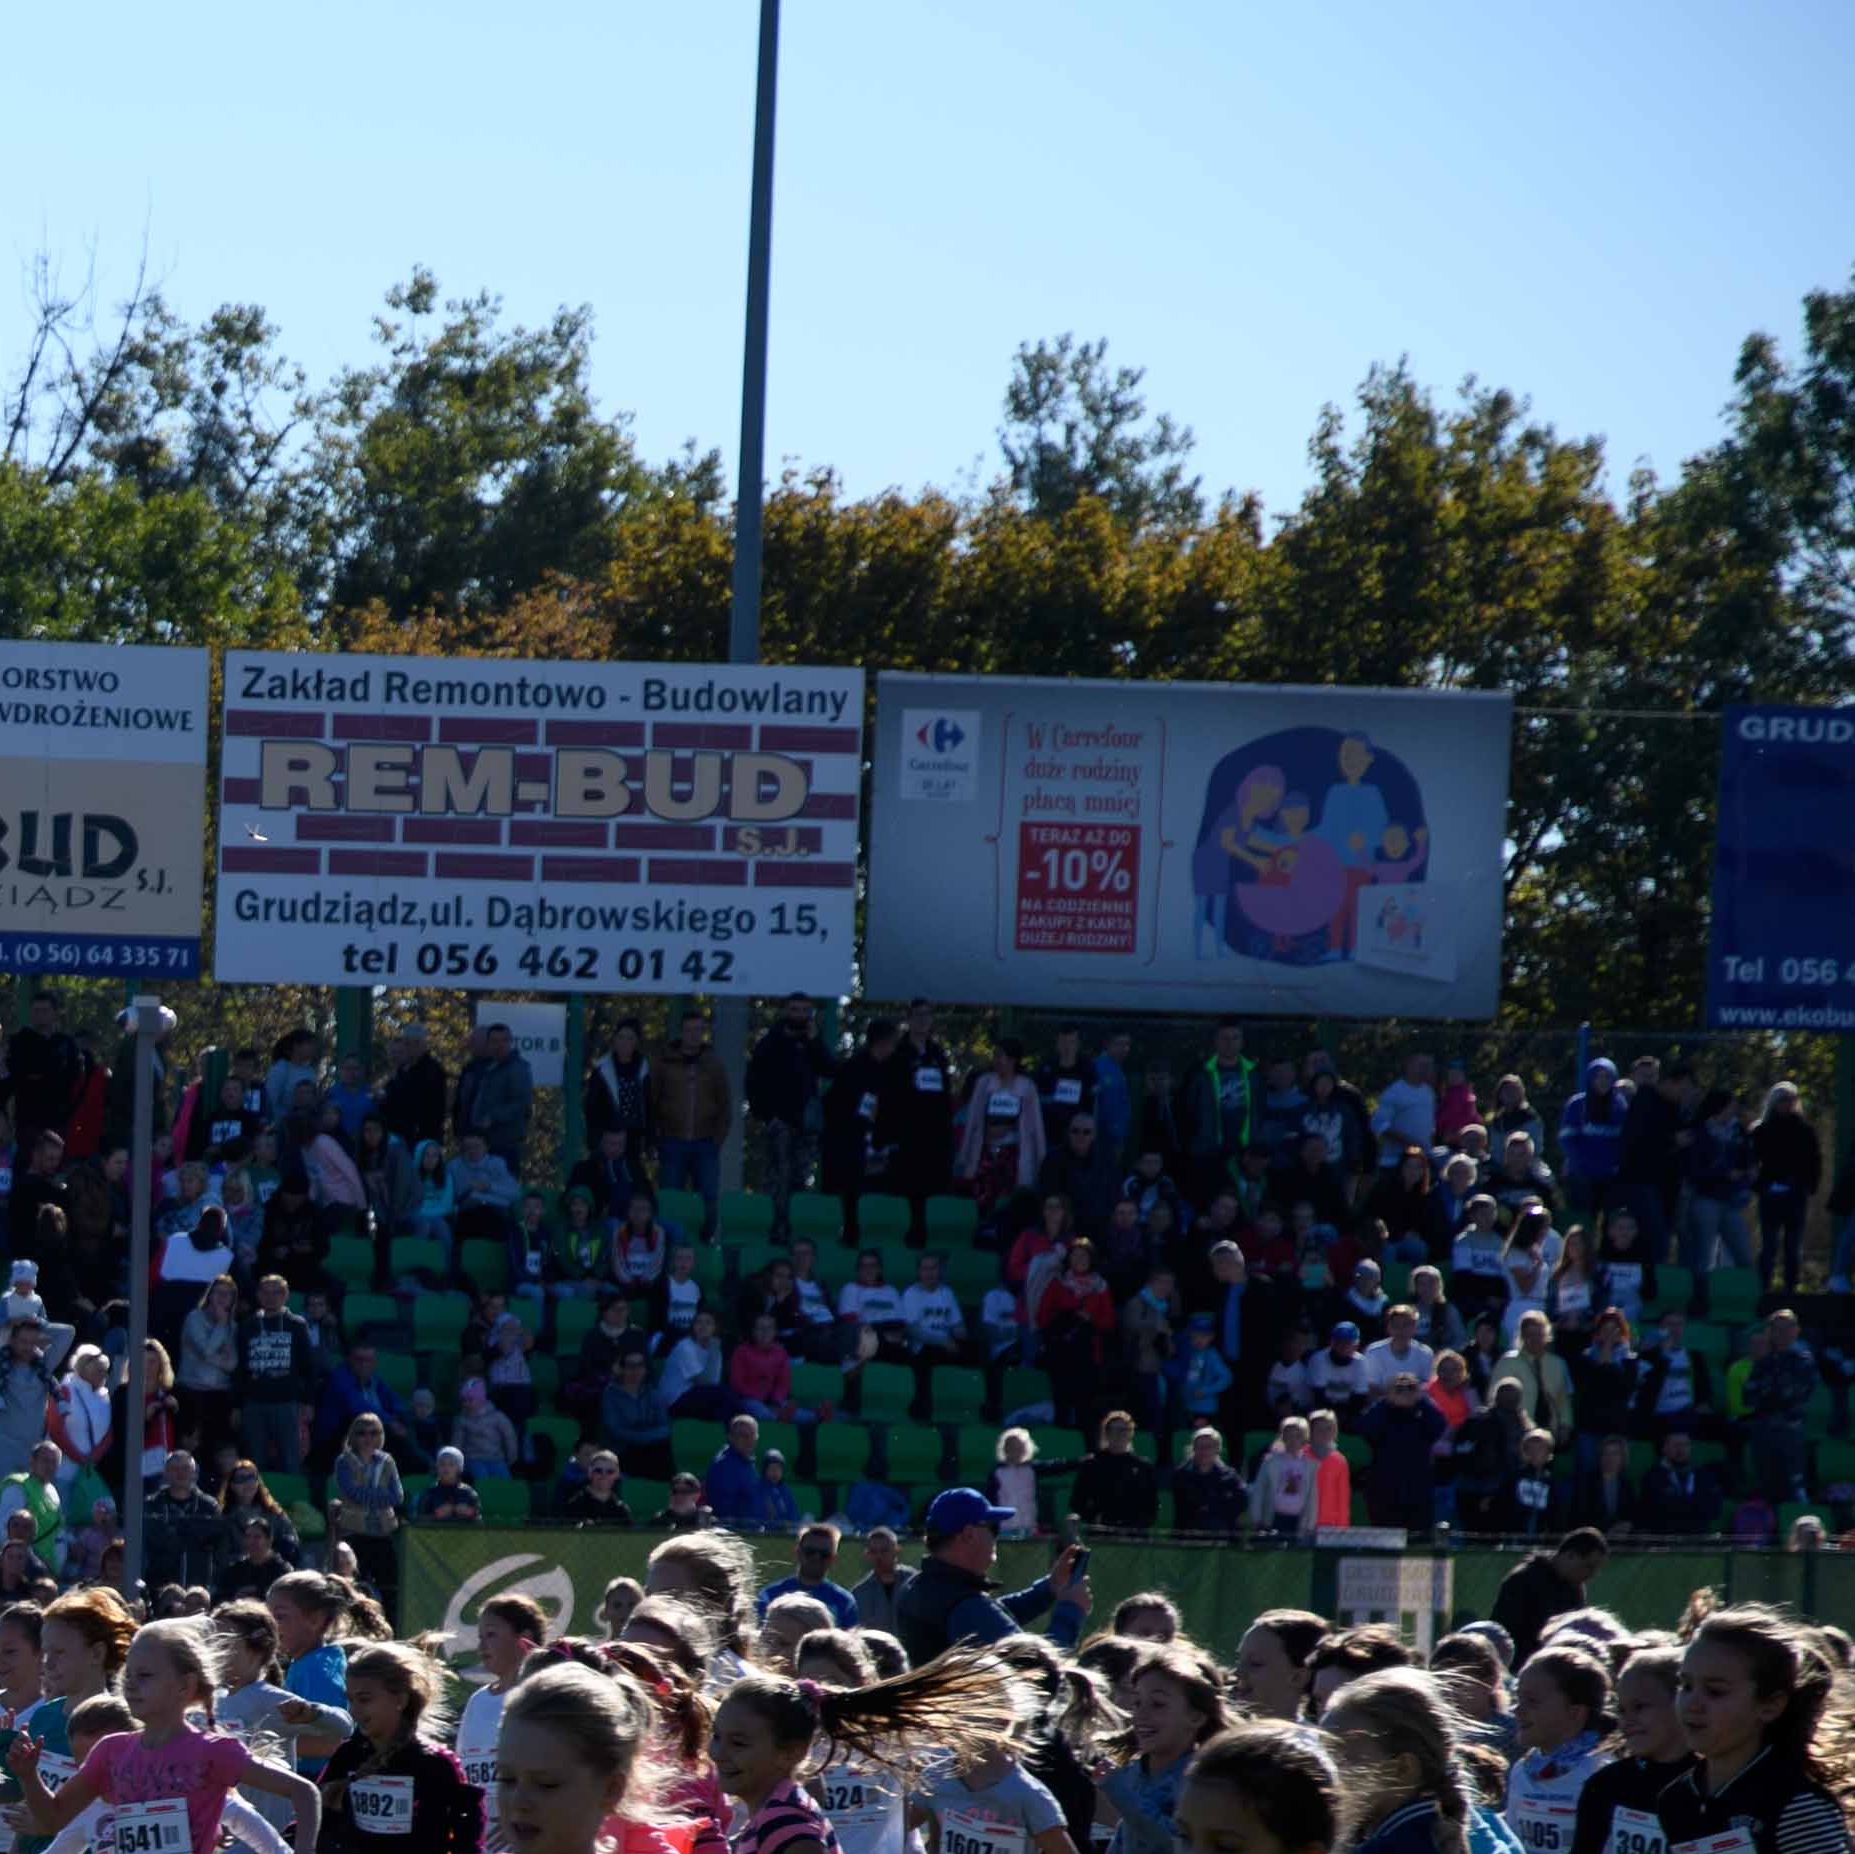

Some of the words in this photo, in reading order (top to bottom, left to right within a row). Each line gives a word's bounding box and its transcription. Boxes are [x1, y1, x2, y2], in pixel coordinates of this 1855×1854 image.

[242, 666, 370, 702] Zakład
[385, 671, 605, 709] Remontowo
[643, 678, 847, 722] Budowlany
[259, 739, 809, 823] REM-BUD
[1025, 848, 1131, 892] -10%
[487, 896, 754, 943] Dąbrowskiego
[87, 945, 113, 965] 64
[119, 946, 160, 967] 335
[343, 941, 397, 976] tel
[417, 944, 498, 977] 056
[518, 945, 599, 980] 462
[618, 947, 664, 981] 01
[680, 948, 734, 983] 42
[1723, 956, 1764, 984] Tel
[1781, 957, 1838, 985] 056
